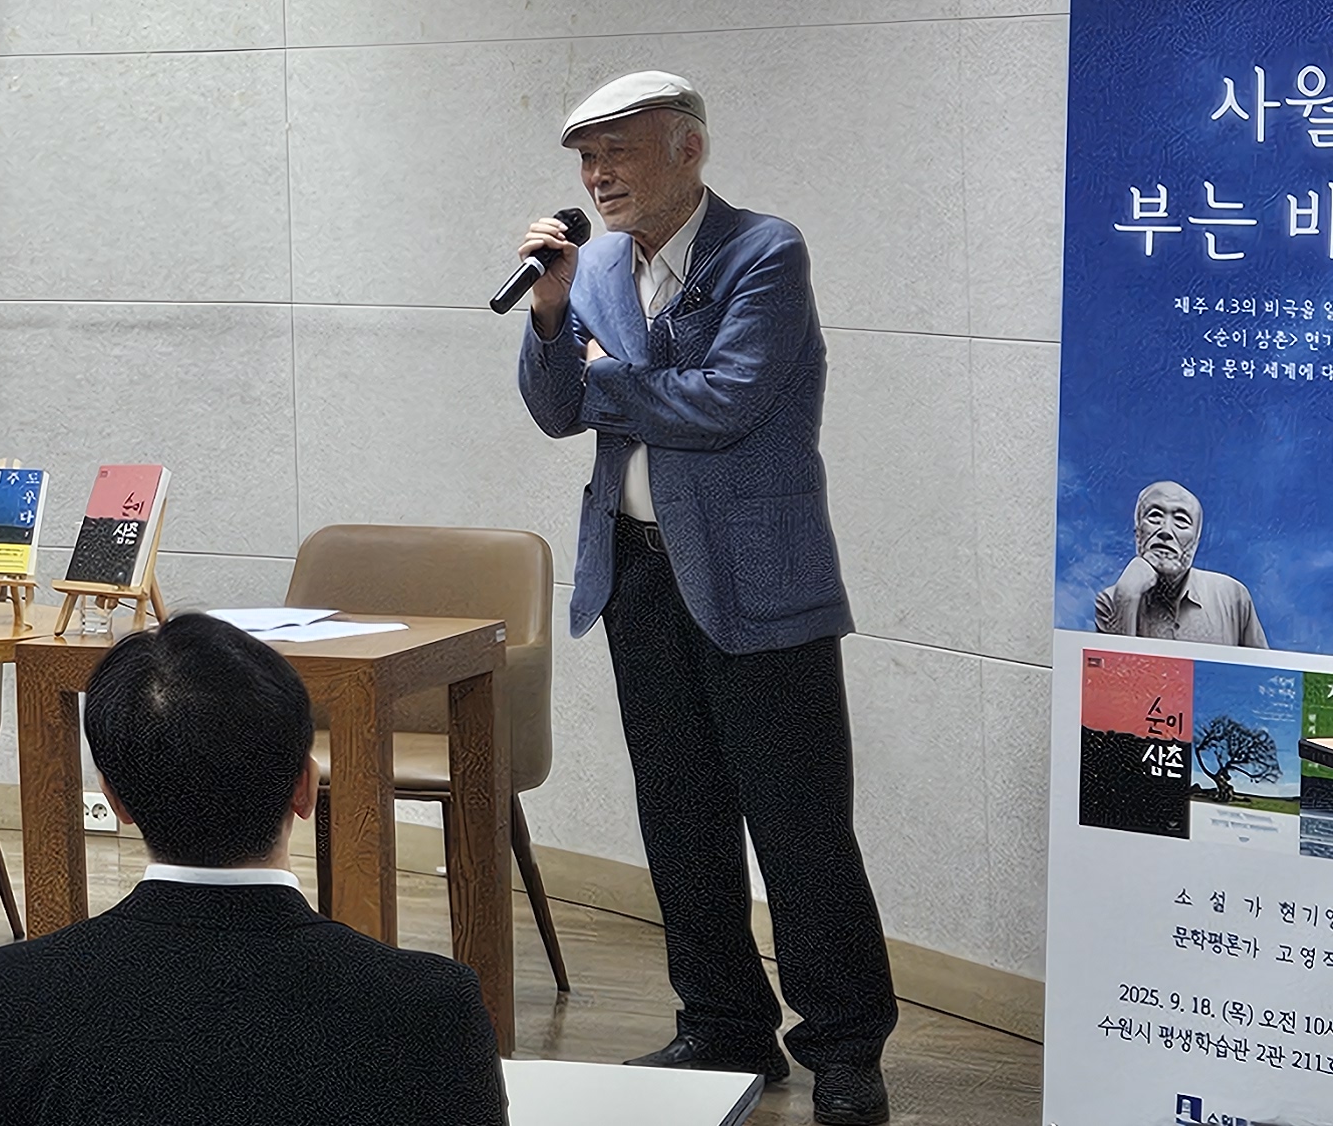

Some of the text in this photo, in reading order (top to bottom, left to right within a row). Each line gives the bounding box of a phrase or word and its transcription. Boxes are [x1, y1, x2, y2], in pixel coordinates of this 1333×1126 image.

[1113, 181, 1258, 261] 부는
[1174, 296, 1209, 315] 제주
[1215, 297, 1256, 317] 4.3의
[1264, 298, 1315, 320] 비극을
[1203, 327, 1247, 348] <순이
[1181, 357, 1215, 377] 삶과
[1221, 359, 1256, 379] 문학
[1263, 361, 1314, 380] 세계에
[1145, 696, 1183, 735] 순이
[1141, 743, 1184, 778] 삼촌
[1172, 926, 1260, 958] 문학평론가
[1118, 984, 1164, 1009] 2025.
[1170, 992, 1185, 1013] 9.
[1192, 996, 1216, 1018] 18.
[1222, 1000, 1254, 1026] (목)
[1258, 1010, 1296, 1034] 오전
[1098, 1015, 1152, 1044] 수원시
[1158, 1025, 1250, 1062] 평생학습관
[1256, 1043, 1286, 1069] 2관
